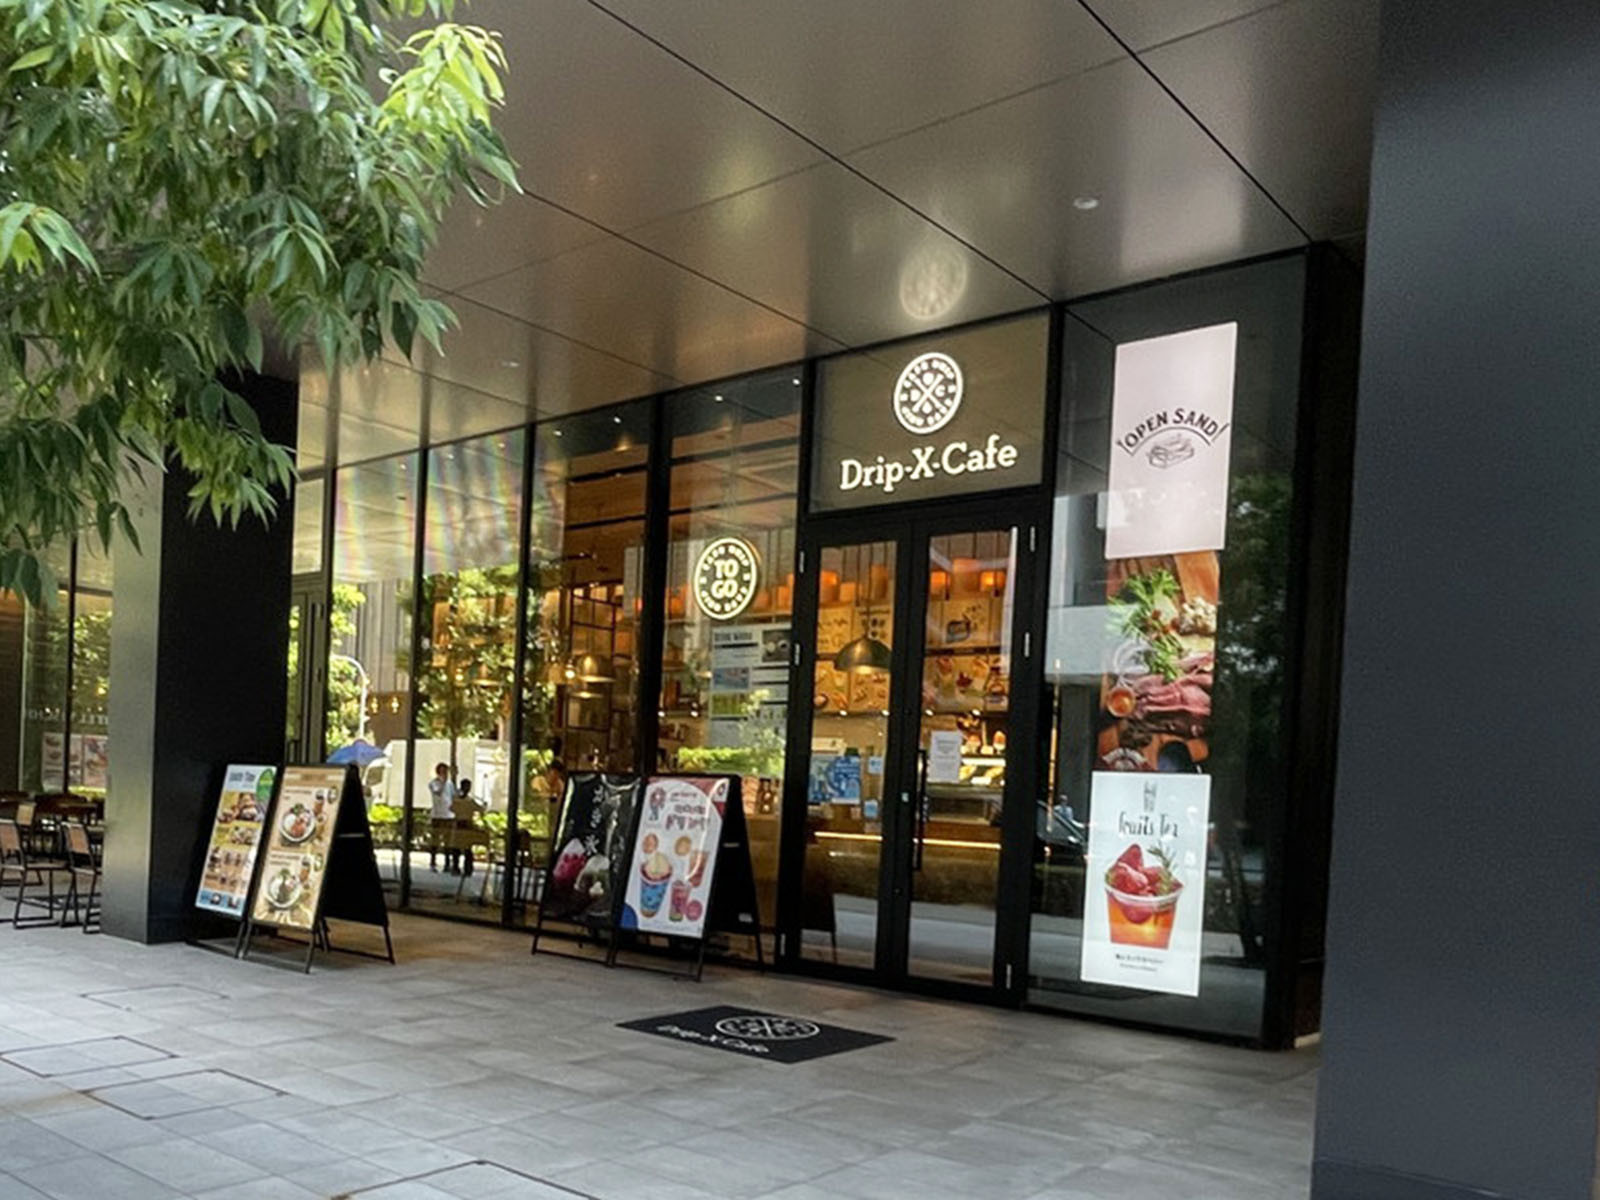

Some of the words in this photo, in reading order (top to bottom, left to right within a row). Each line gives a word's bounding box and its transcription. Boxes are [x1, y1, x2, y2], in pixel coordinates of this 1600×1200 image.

[1124, 410, 1169, 450] OPEN
[1172, 407, 1220, 437] SAND
[713, 558, 740, 579] TO
[710, 579, 739, 600] GO
